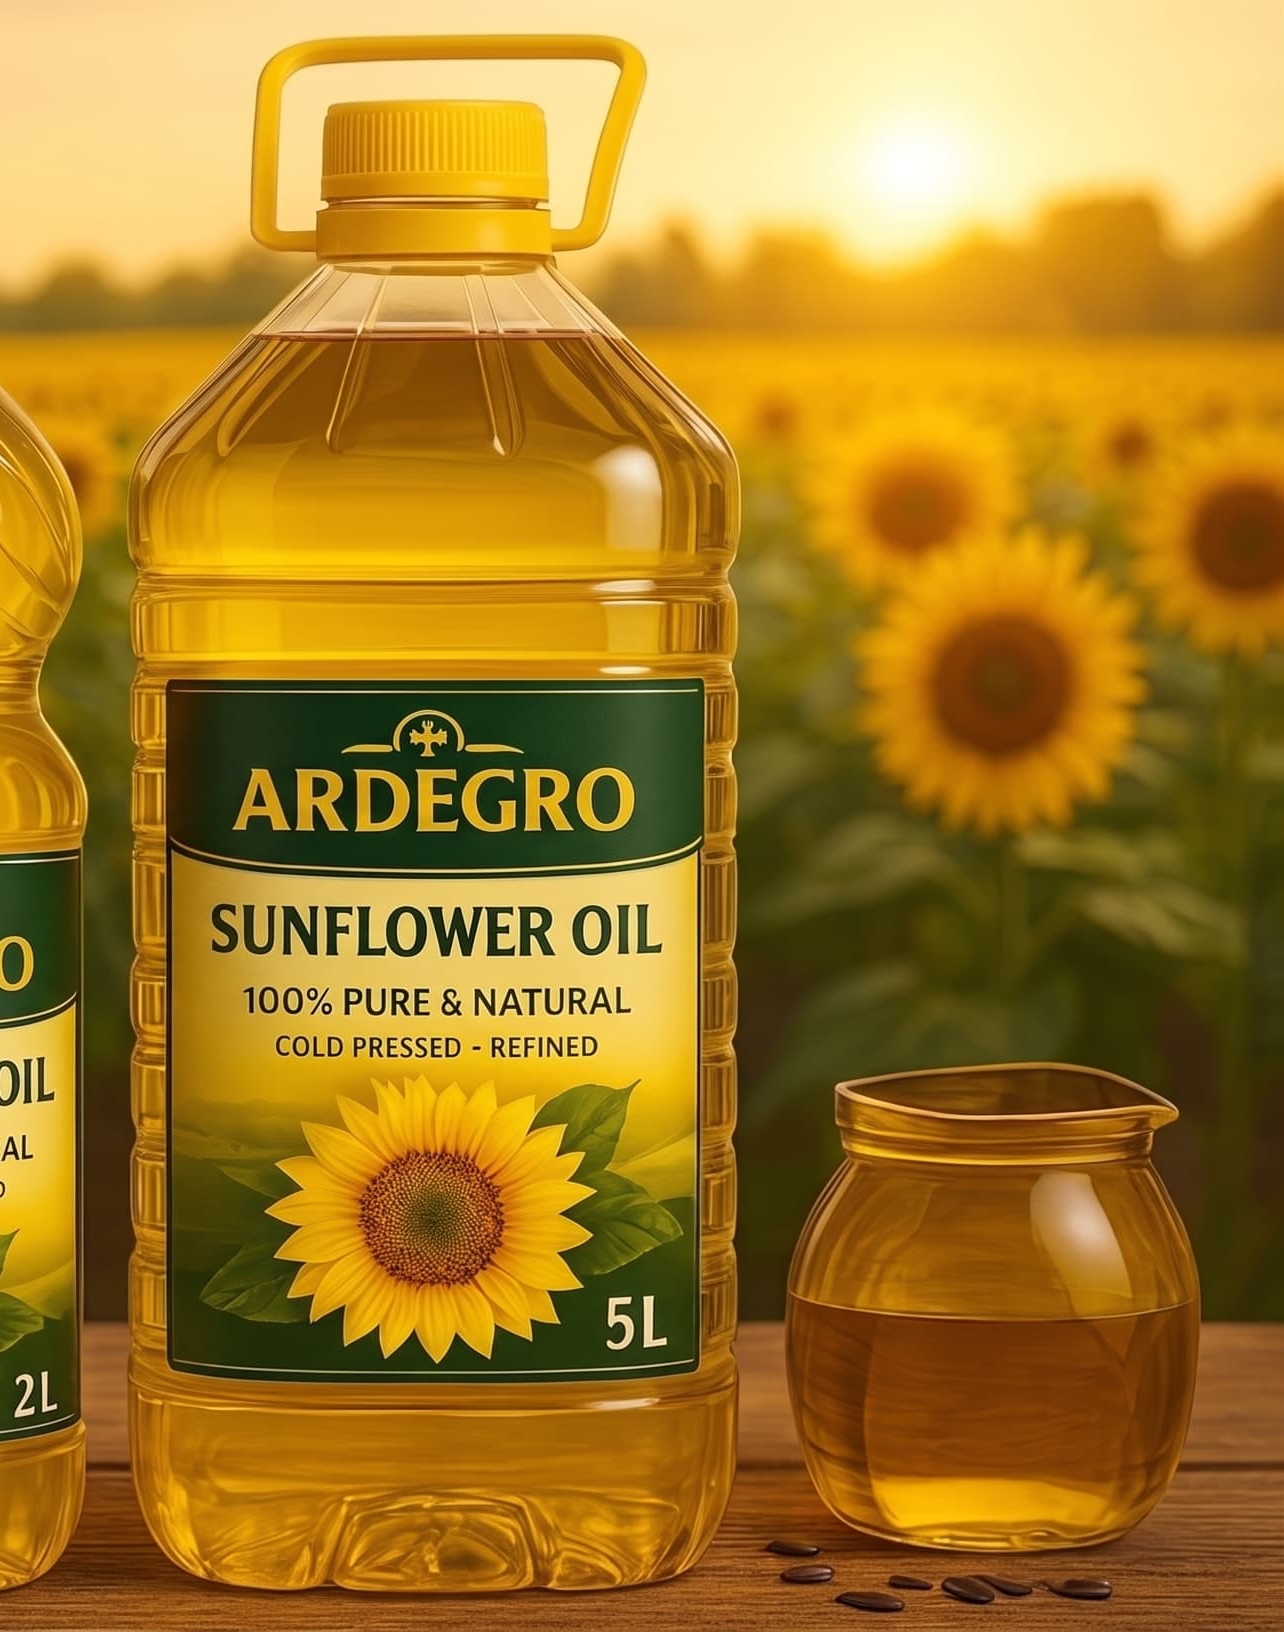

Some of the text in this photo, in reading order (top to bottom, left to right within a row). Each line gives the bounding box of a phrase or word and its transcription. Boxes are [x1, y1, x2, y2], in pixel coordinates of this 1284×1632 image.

[232, 767, 635, 833] ARDEGRO
[211, 902, 662, 957] SUNFLOWER OIL
[243, 986, 631, 1016] 100% PURE & NATURAL
[275, 1035, 344, 1058] COLD
[352, 1037, 462, 1058] PRESSED
[490, 1036, 598, 1058] REFINED
[606, 1295, 668, 1351] 5L
[15, 1369, 58, 1418] 2L
